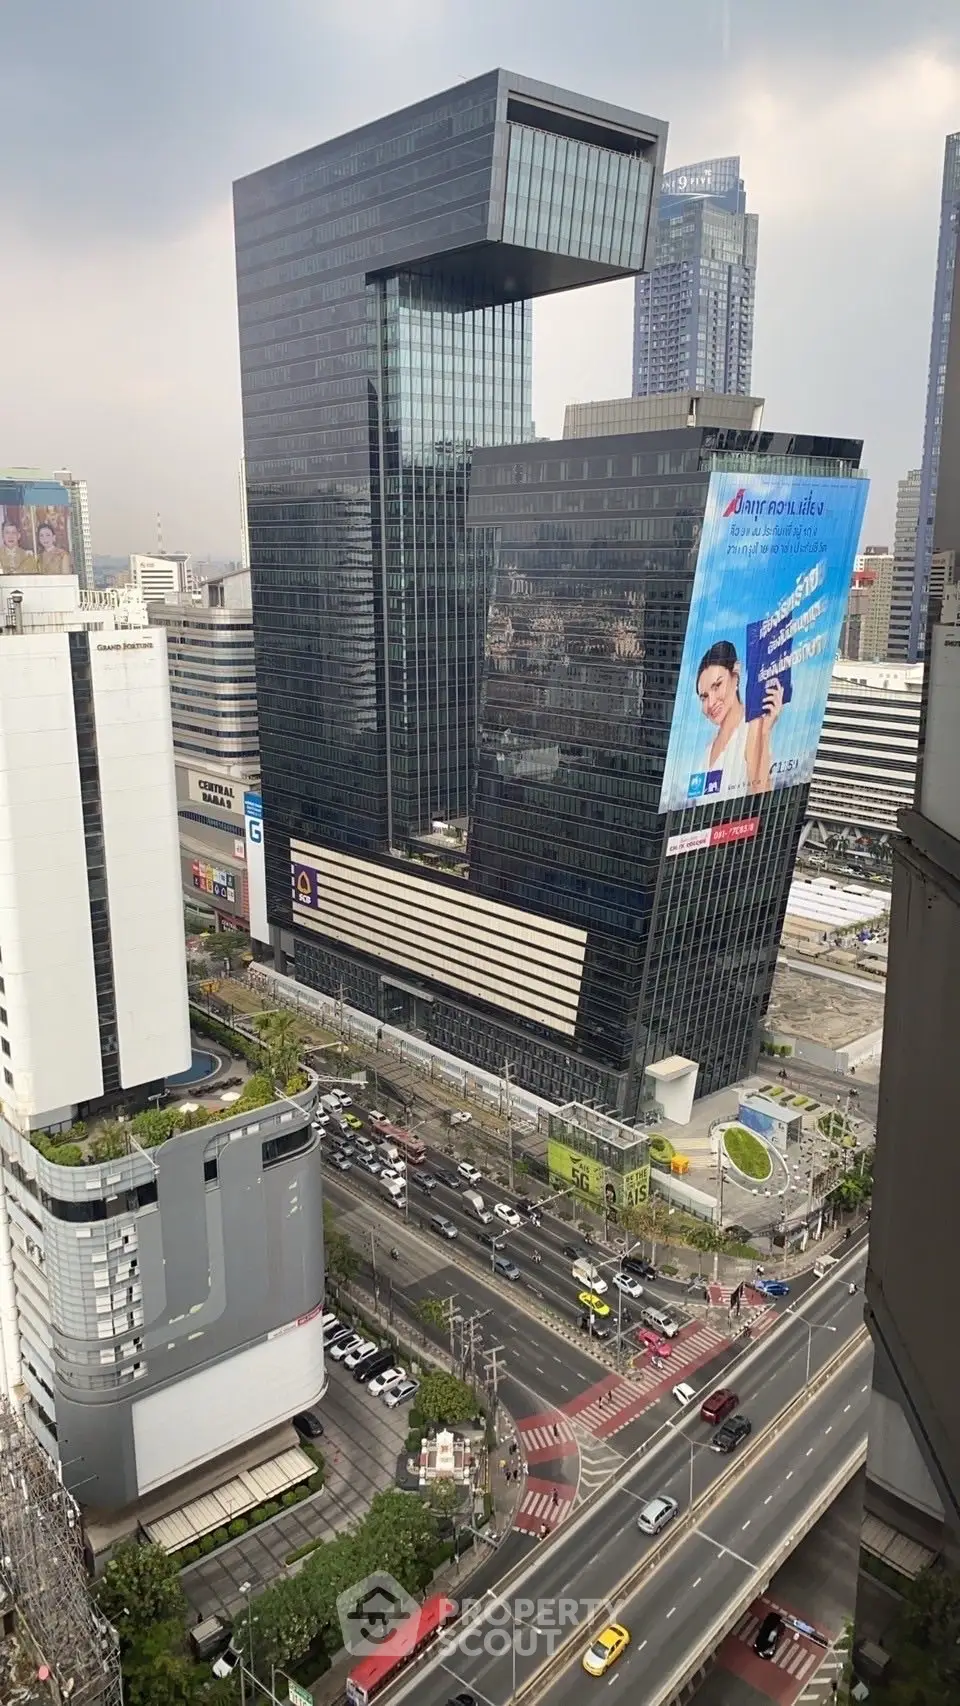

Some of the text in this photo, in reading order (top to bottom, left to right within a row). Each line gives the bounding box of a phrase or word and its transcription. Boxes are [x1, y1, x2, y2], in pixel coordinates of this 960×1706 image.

[679, 175, 688, 190] 9
[122, 642, 154, 651] FORTUNE
[198, 780, 235, 798] CENTRAL
[202, 793, 232, 809] RAMA 9
[249, 820, 262, 843] G
[571, 1167, 590, 1192] 5G
[635, 1168, 648, 1181] THE
